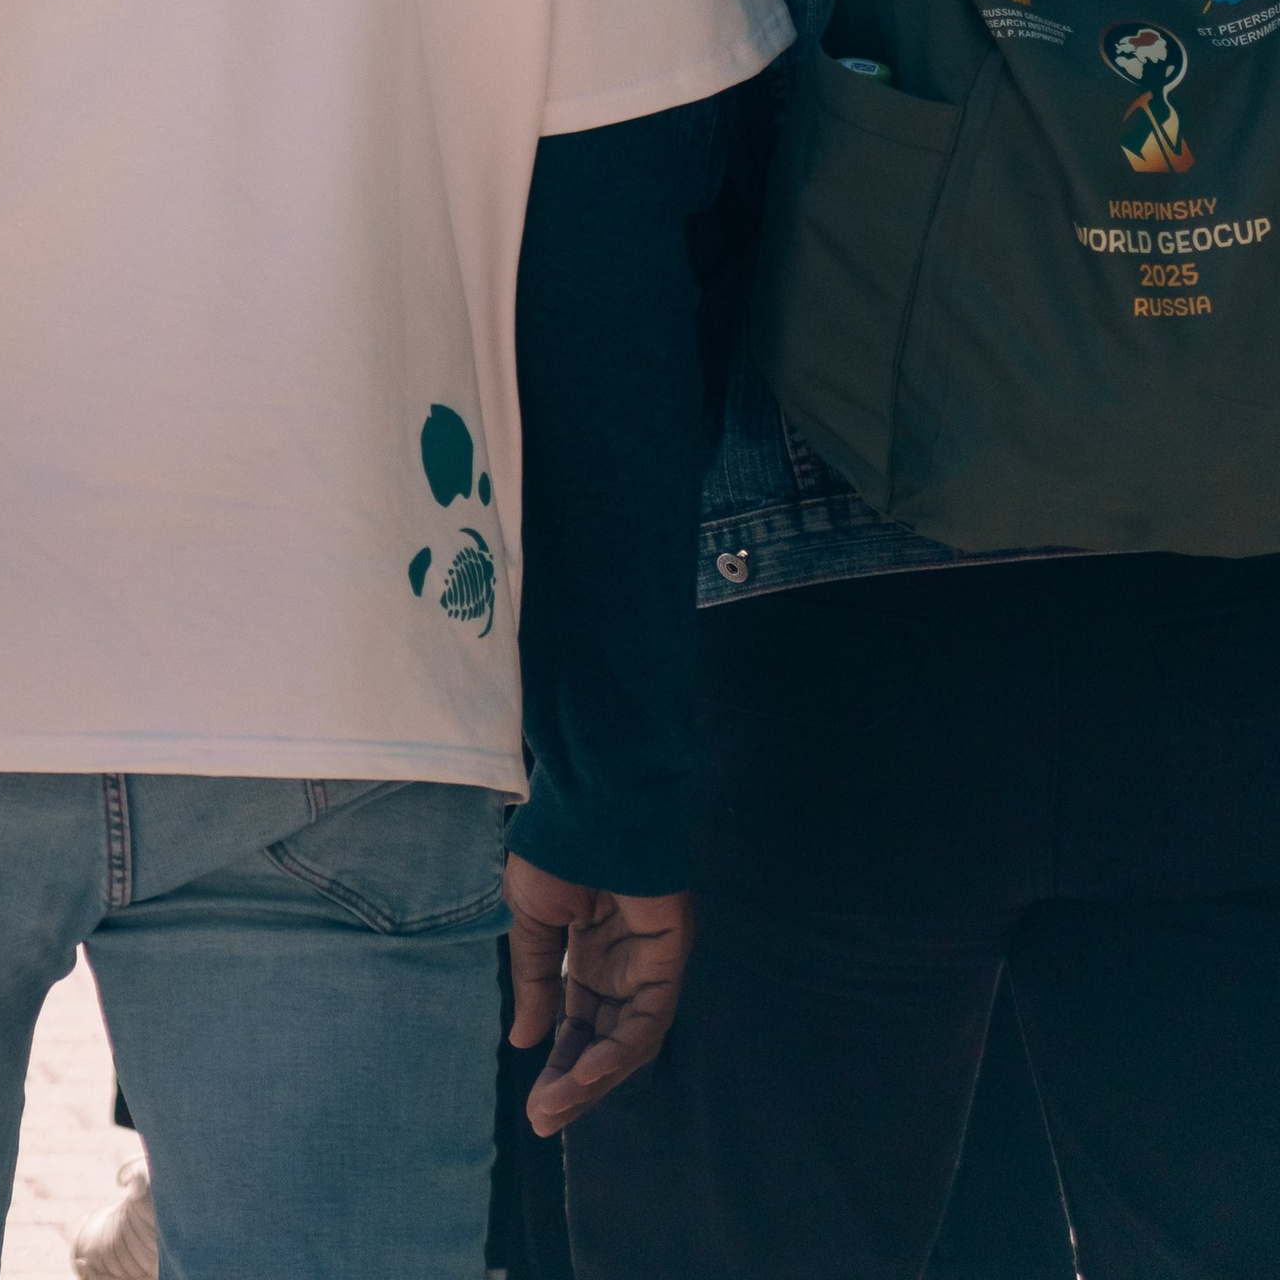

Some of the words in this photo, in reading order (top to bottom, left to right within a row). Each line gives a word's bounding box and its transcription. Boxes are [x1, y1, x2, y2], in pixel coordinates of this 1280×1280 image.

[1018, 30, 1064, 45] KARPINSKY
[1028, 22, 1066, 39] INSTITUTE
[1197, 27, 1217, 37] ST.
[1109, 197, 1218, 222] KARPINSKY
[1073, 220, 1152, 255] WORLD
[1157, 217, 1272, 255] GEOCUP
[1140, 262, 1200, 288] 2025
[1133, 295, 1213, 318] RUSSIA
